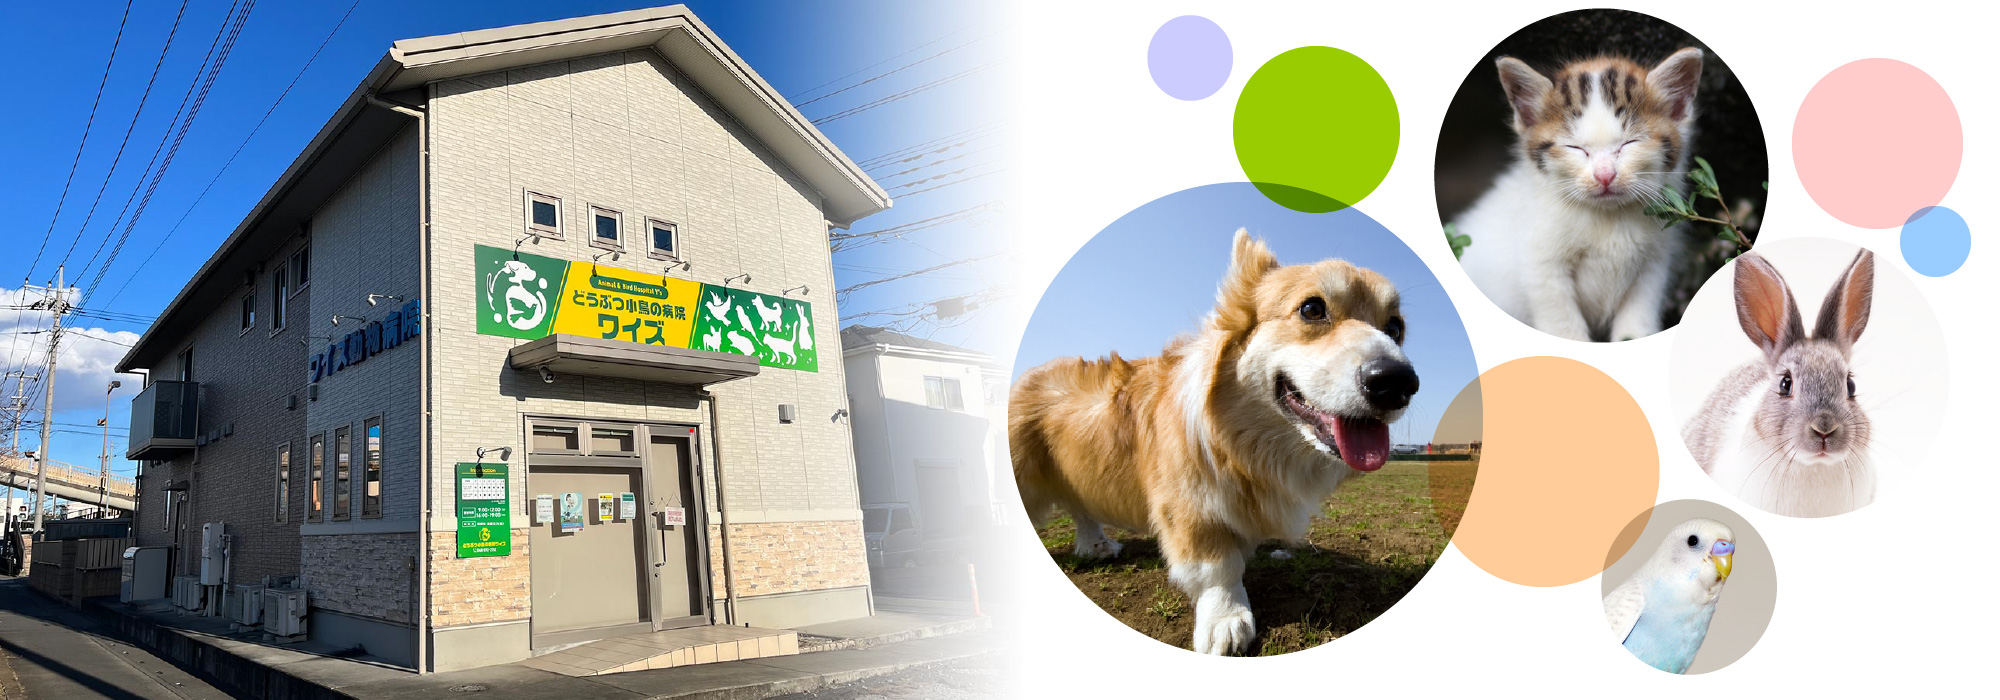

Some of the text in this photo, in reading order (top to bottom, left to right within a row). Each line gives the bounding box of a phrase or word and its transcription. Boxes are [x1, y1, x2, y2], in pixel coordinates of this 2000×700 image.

[598, 279, 616, 288] Animal
[622, 283, 633, 291] Bird
[633, 285, 654, 295] Hospital
[655, 288, 663, 296] Y's
[572, 289, 686, 320] どうぶつ小鳥の病院
[309, 298, 419, 383] ワイズ動物病院
[597, 313, 666, 346] ワイズ
